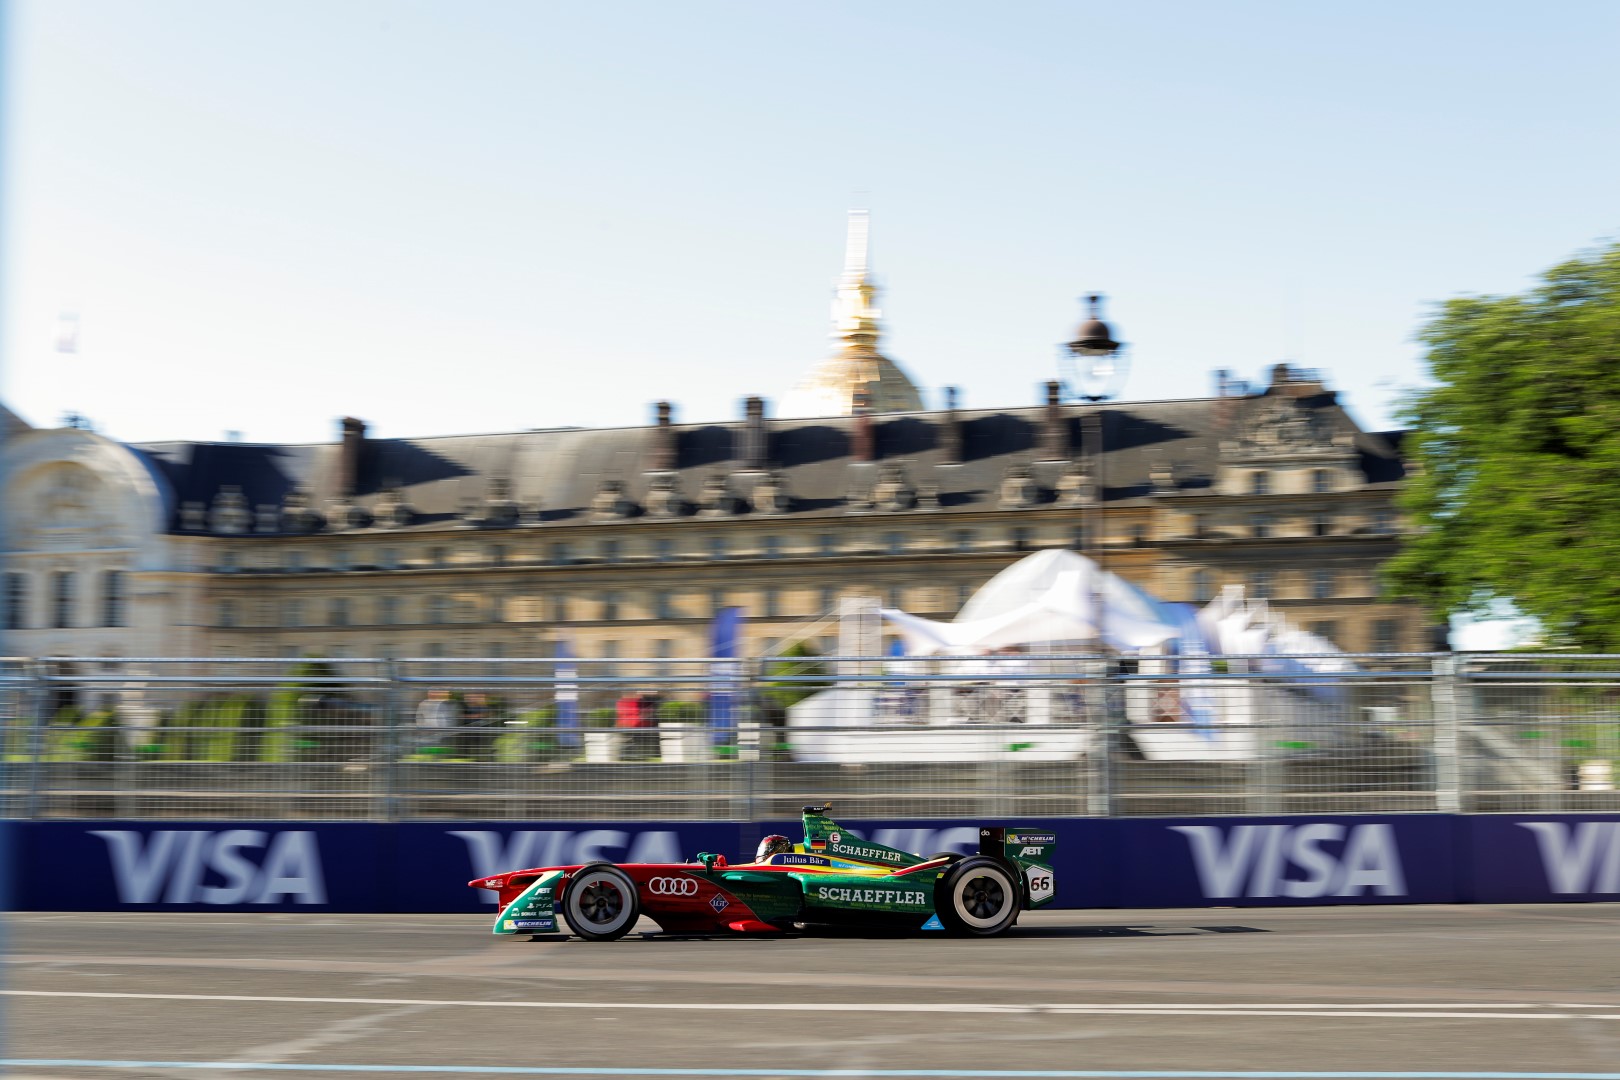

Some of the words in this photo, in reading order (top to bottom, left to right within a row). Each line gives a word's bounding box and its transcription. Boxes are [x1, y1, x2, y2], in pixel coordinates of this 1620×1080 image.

[783, 855, 807, 864] Julius
[809, 856, 824, 865] Bär
[832, 843, 901, 862] SCHAEFFLER
[1019, 846, 1044, 857] ABT
[85, 829, 329, 905] VISA
[1165, 823, 1409, 898] VISA
[535, 887, 552, 896] ABT
[1031, 876, 1050, 892] 66
[818, 887, 926, 905] SCHAEFFLER
